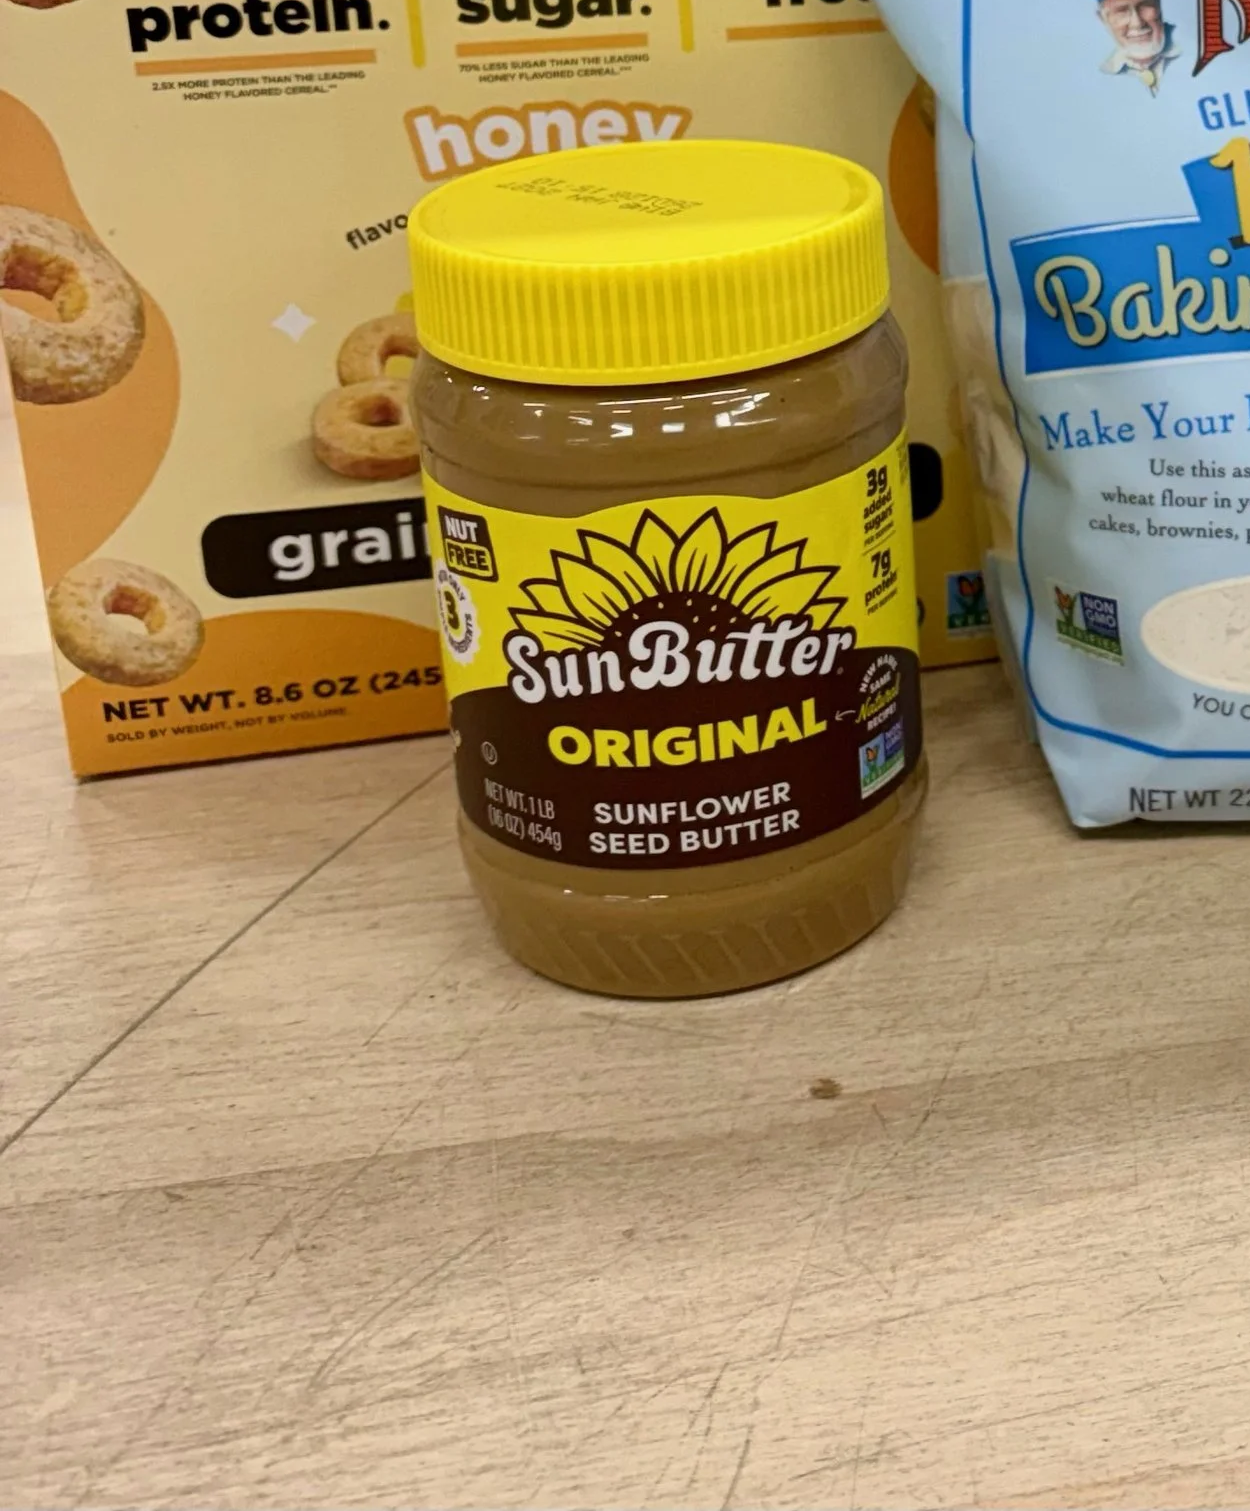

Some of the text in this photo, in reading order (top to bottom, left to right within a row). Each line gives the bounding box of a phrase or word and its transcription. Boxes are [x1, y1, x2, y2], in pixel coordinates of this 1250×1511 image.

[459, 54, 650, 73] 70% LESS SUGAR THAN THE LEADING
[479, 70, 574, 83] HONEY FLAVORED
[1039, 409, 1136, 451] Make
[1141, 401, 1235, 440] Your
[866, 465, 887, 497] 3g
[1149, 458, 1185, 477] Use
[1191, 459, 1226, 478] this
[864, 487, 892, 519] added
[1101, 486, 1155, 506] wheat
[1161, 489, 1208, 509] flour
[1213, 490, 1232, 510] in
[444, 515, 478, 543] NUT
[864, 504, 893, 533] sugars
[1089, 514, 1141, 536] cakes,
[1147, 519, 1239, 541] brownies,
[269, 512, 432, 582] grai
[447, 542, 489, 571] FREE
[871, 548, 891, 578] 7g
[865, 569, 897, 606] protein
[103, 665, 442, 722] NET WT. 8.6 OZ (245
[1192, 692, 1234, 717] YOU
[547, 698, 826, 768] ORIGINAL
[484, 778, 555, 820] NET WT. LB
[593, 781, 792, 825] SUNFLOWER
[1129, 787, 1184, 813] NET
[1187, 789, 1220, 808] WT
[528, 822, 562, 852] 454g
[589, 808, 801, 855] SEED BUTTER
